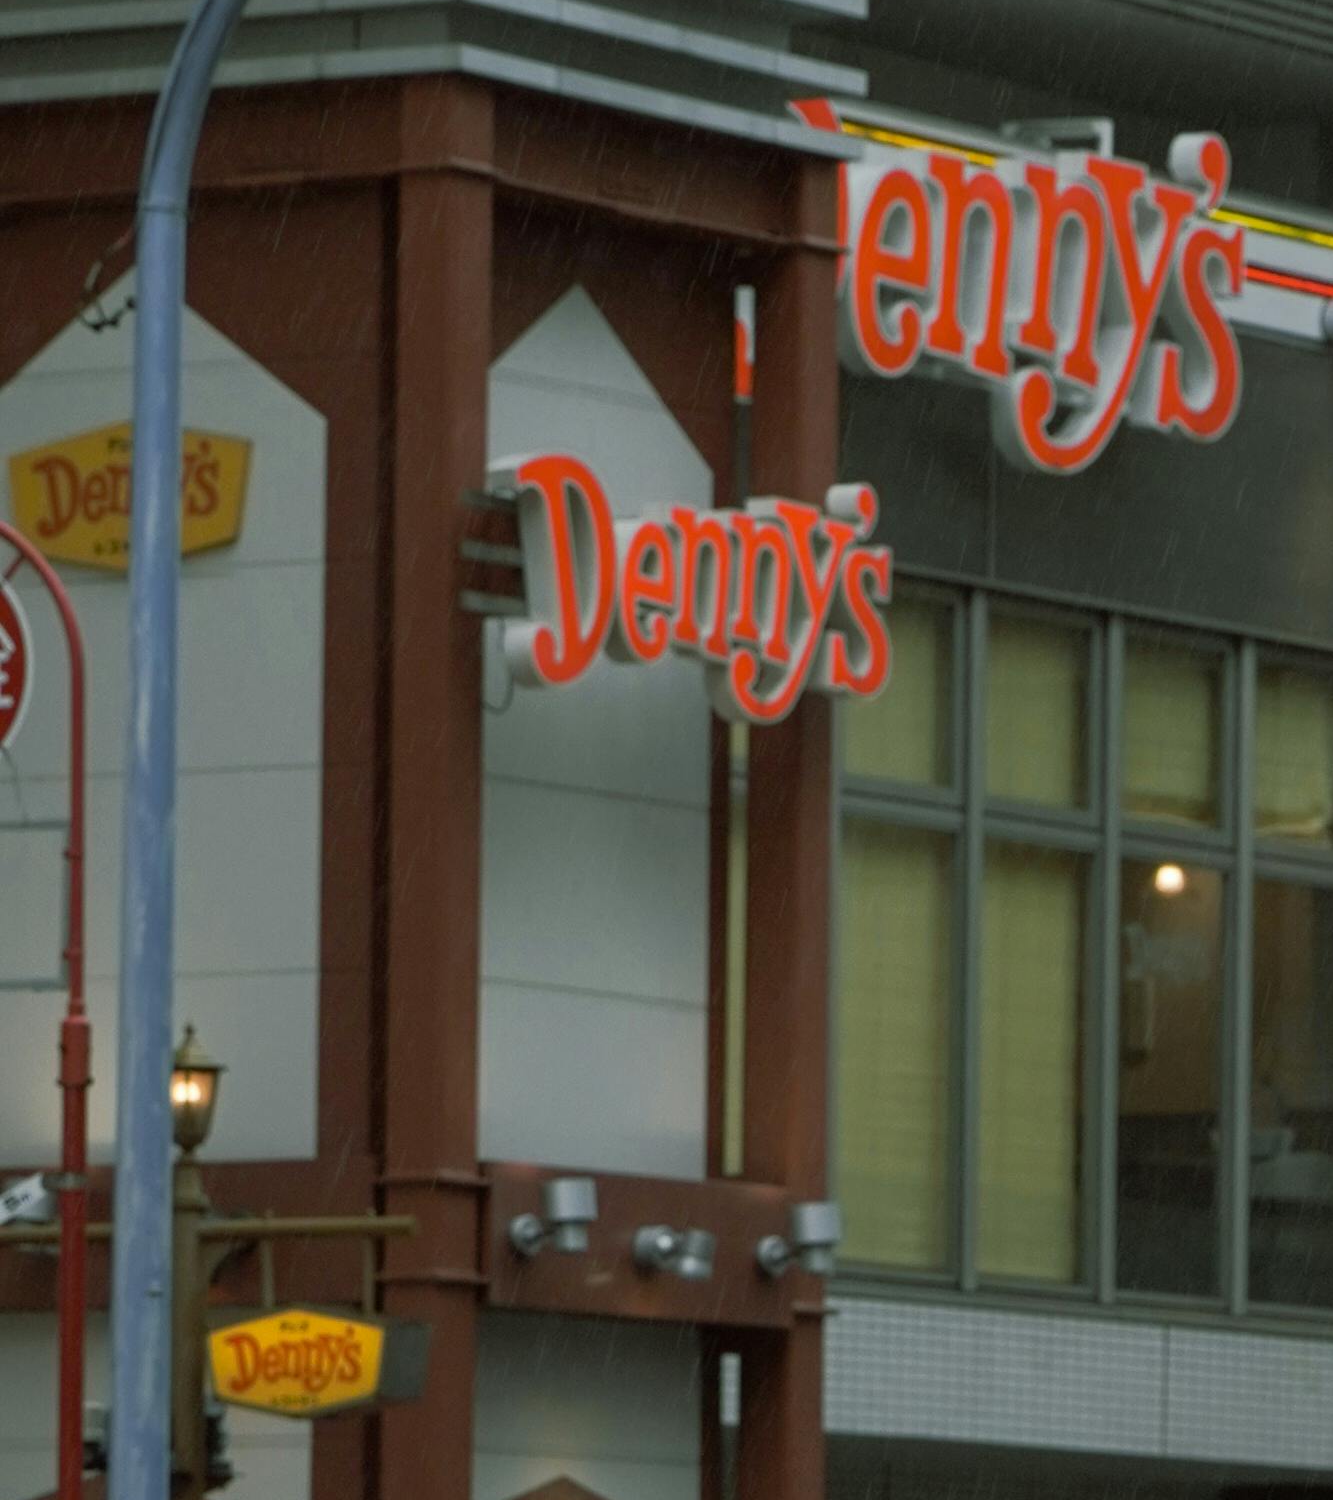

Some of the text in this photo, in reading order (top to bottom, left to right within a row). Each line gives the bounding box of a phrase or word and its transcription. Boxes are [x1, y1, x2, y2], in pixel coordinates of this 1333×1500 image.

[787, 98, 1245, 469] enny's
[518, 455, 890, 719] Denny's
[225, 1324, 362, 1393] Denny's
